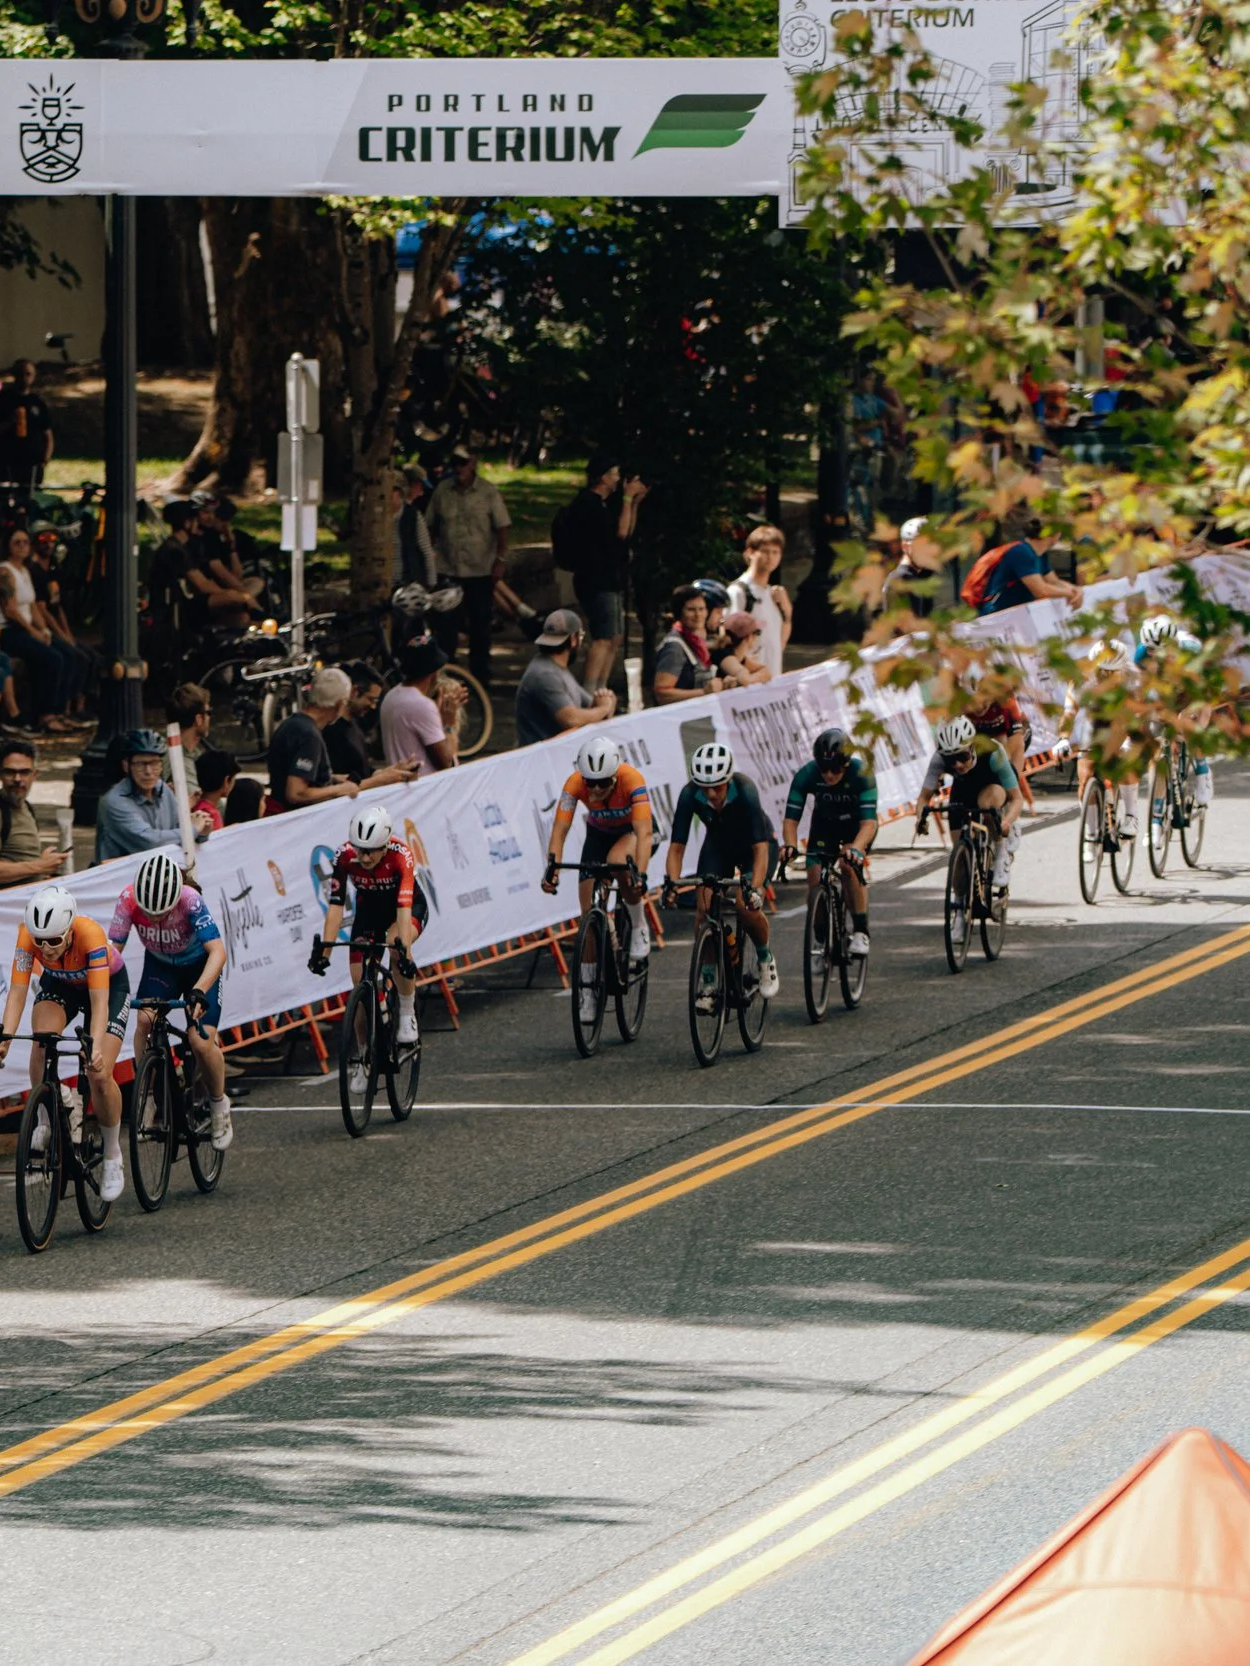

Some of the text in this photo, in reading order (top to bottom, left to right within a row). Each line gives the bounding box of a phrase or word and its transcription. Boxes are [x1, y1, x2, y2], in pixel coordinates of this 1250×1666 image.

[387, 94, 593, 112] PORTLAND
[358, 126, 623, 162] CRITERIUM
[138, 923, 181, 943] ORION
